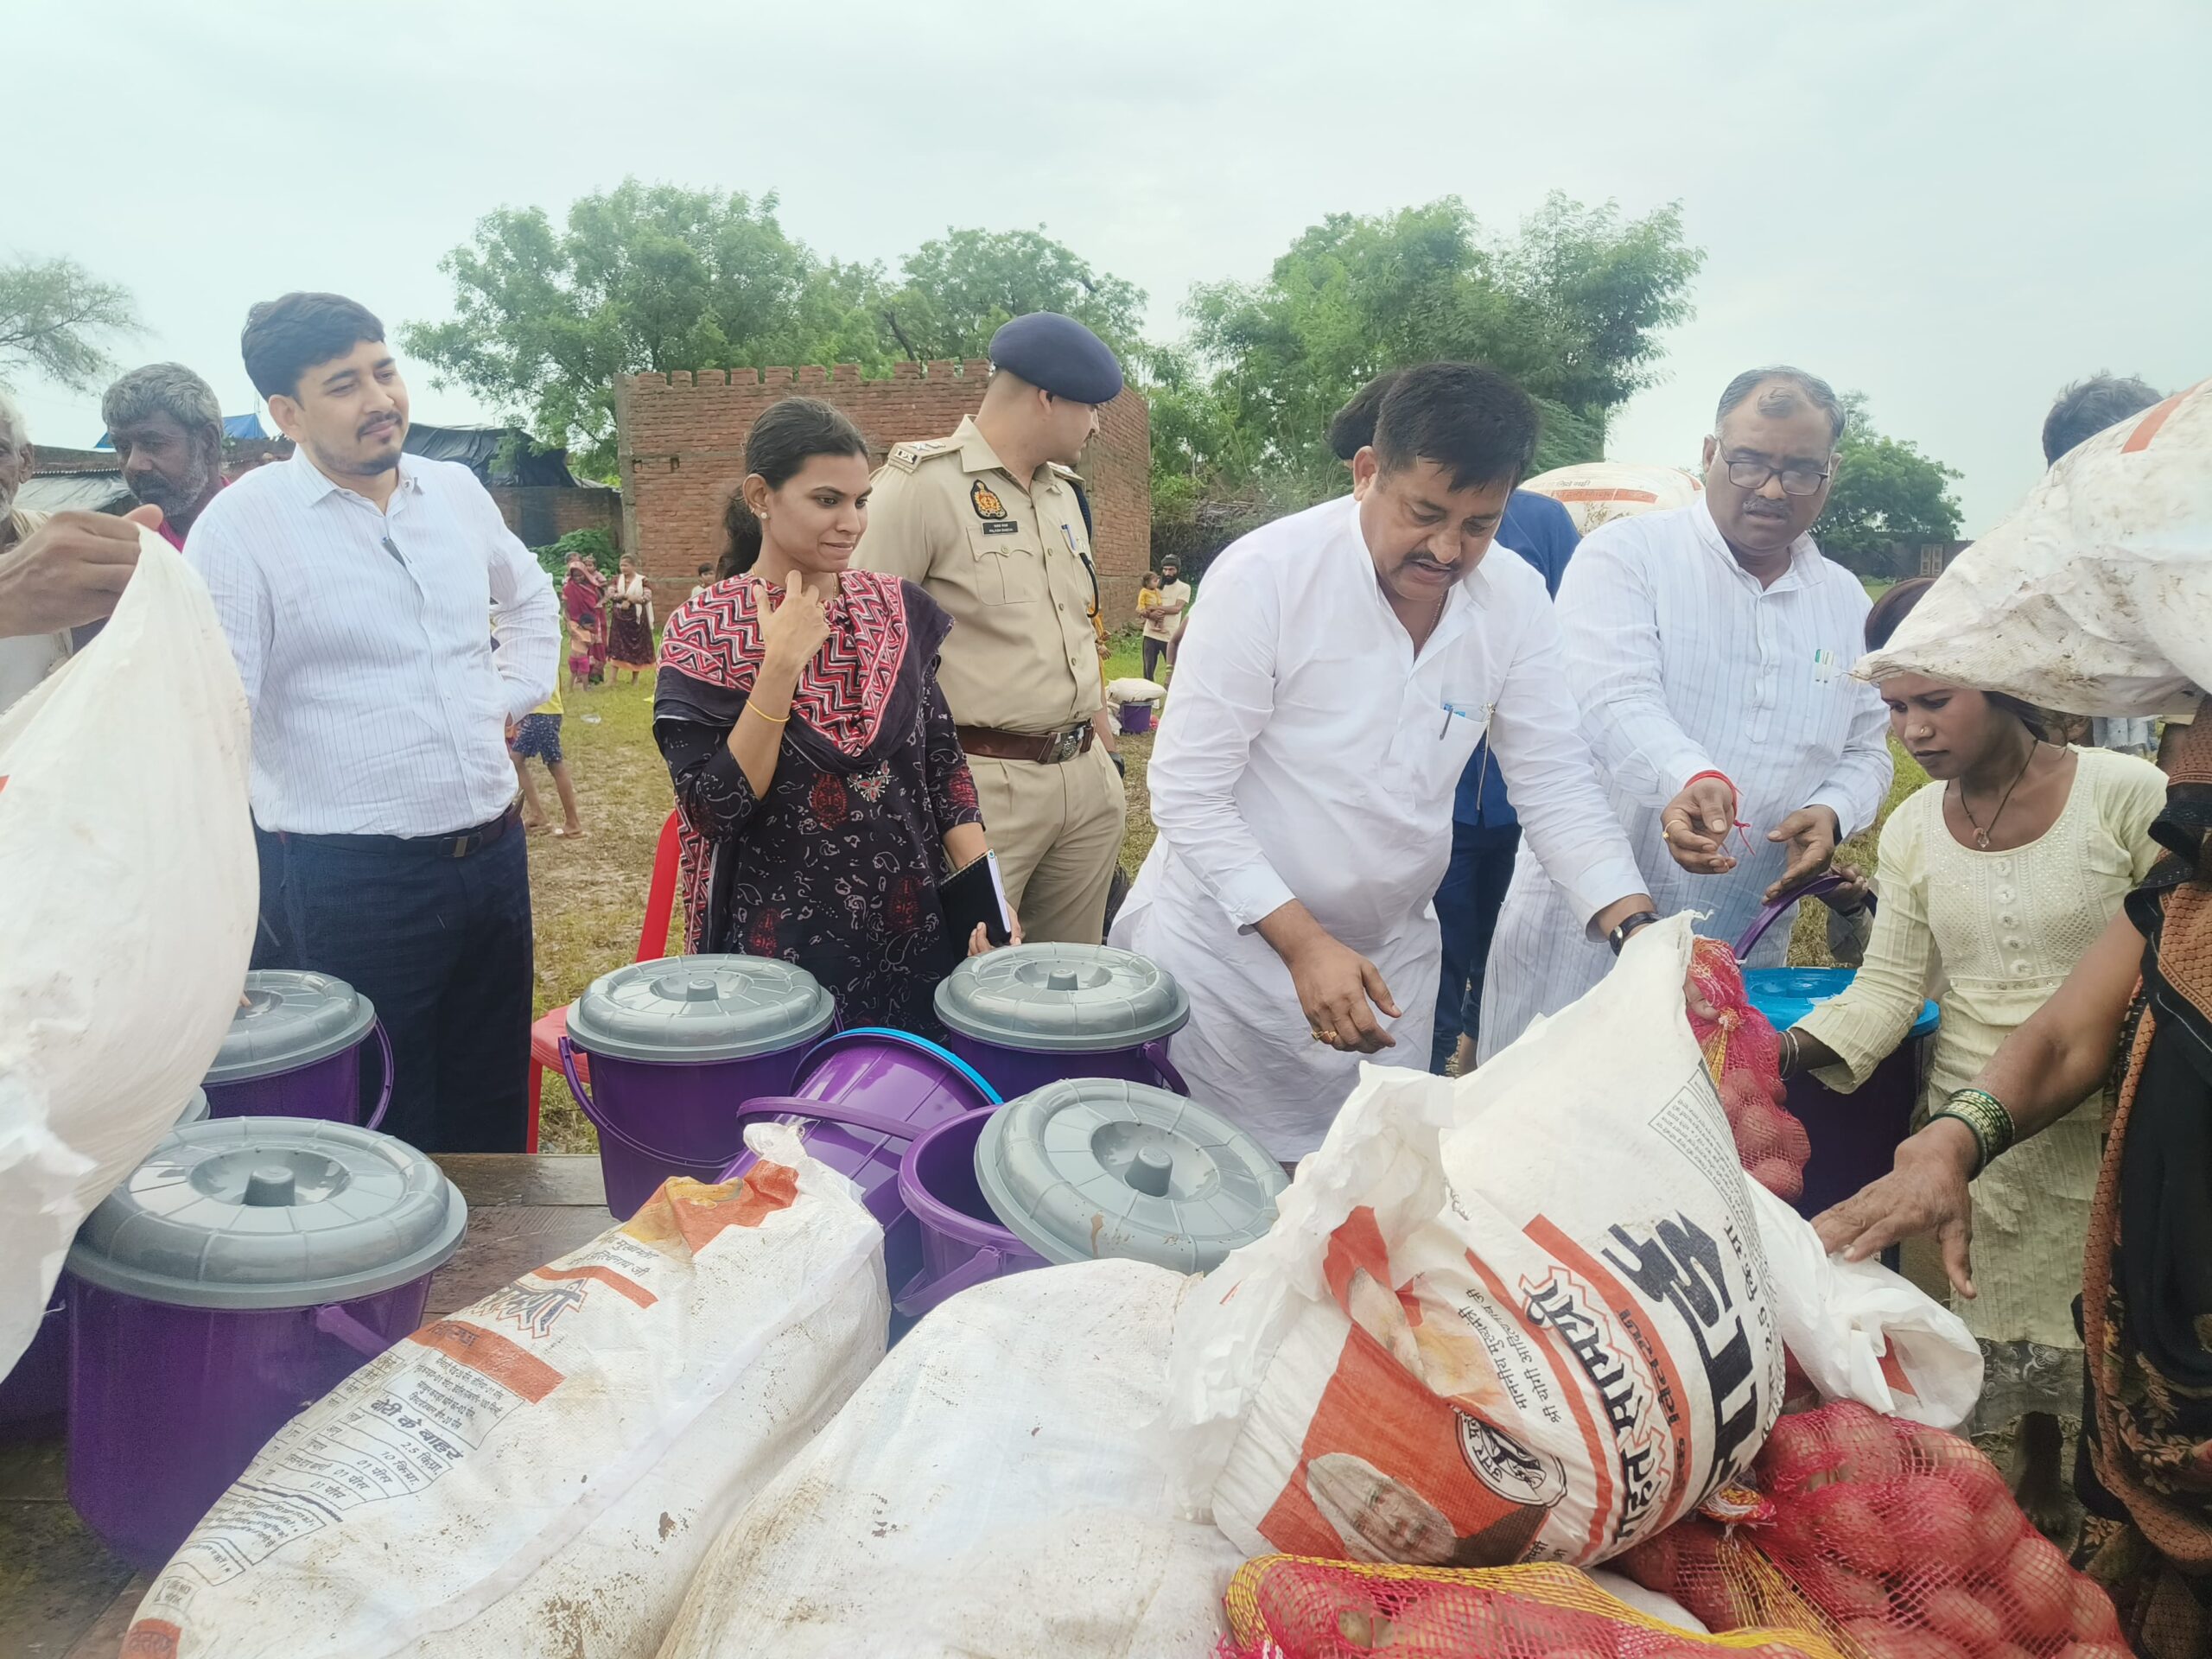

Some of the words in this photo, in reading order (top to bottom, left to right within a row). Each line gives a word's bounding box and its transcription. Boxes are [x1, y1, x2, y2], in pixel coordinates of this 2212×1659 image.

[1466, 1288, 1484, 1303] जी
[1459, 1306, 1504, 1355] मुख्यमंत्री
[1482, 1305, 1533, 1363] आदित्यनाथ
[1522, 1278, 1643, 1439] सामग्री
[1494, 1357, 1528, 1410] माननीय
[1523, 1368, 1549, 1402] योगी
[371, 1398, 403, 1417] बोरी
[397, 1417, 423, 1429] के
[418, 1428, 464, 1460] बाहर
[1542, 1405, 1562, 1423] श्री
[382, 1451, 395, 1460] 10
[401, 1441, 417, 1454] 2.5
[1472, 1446, 1503, 1484] उत्तर
